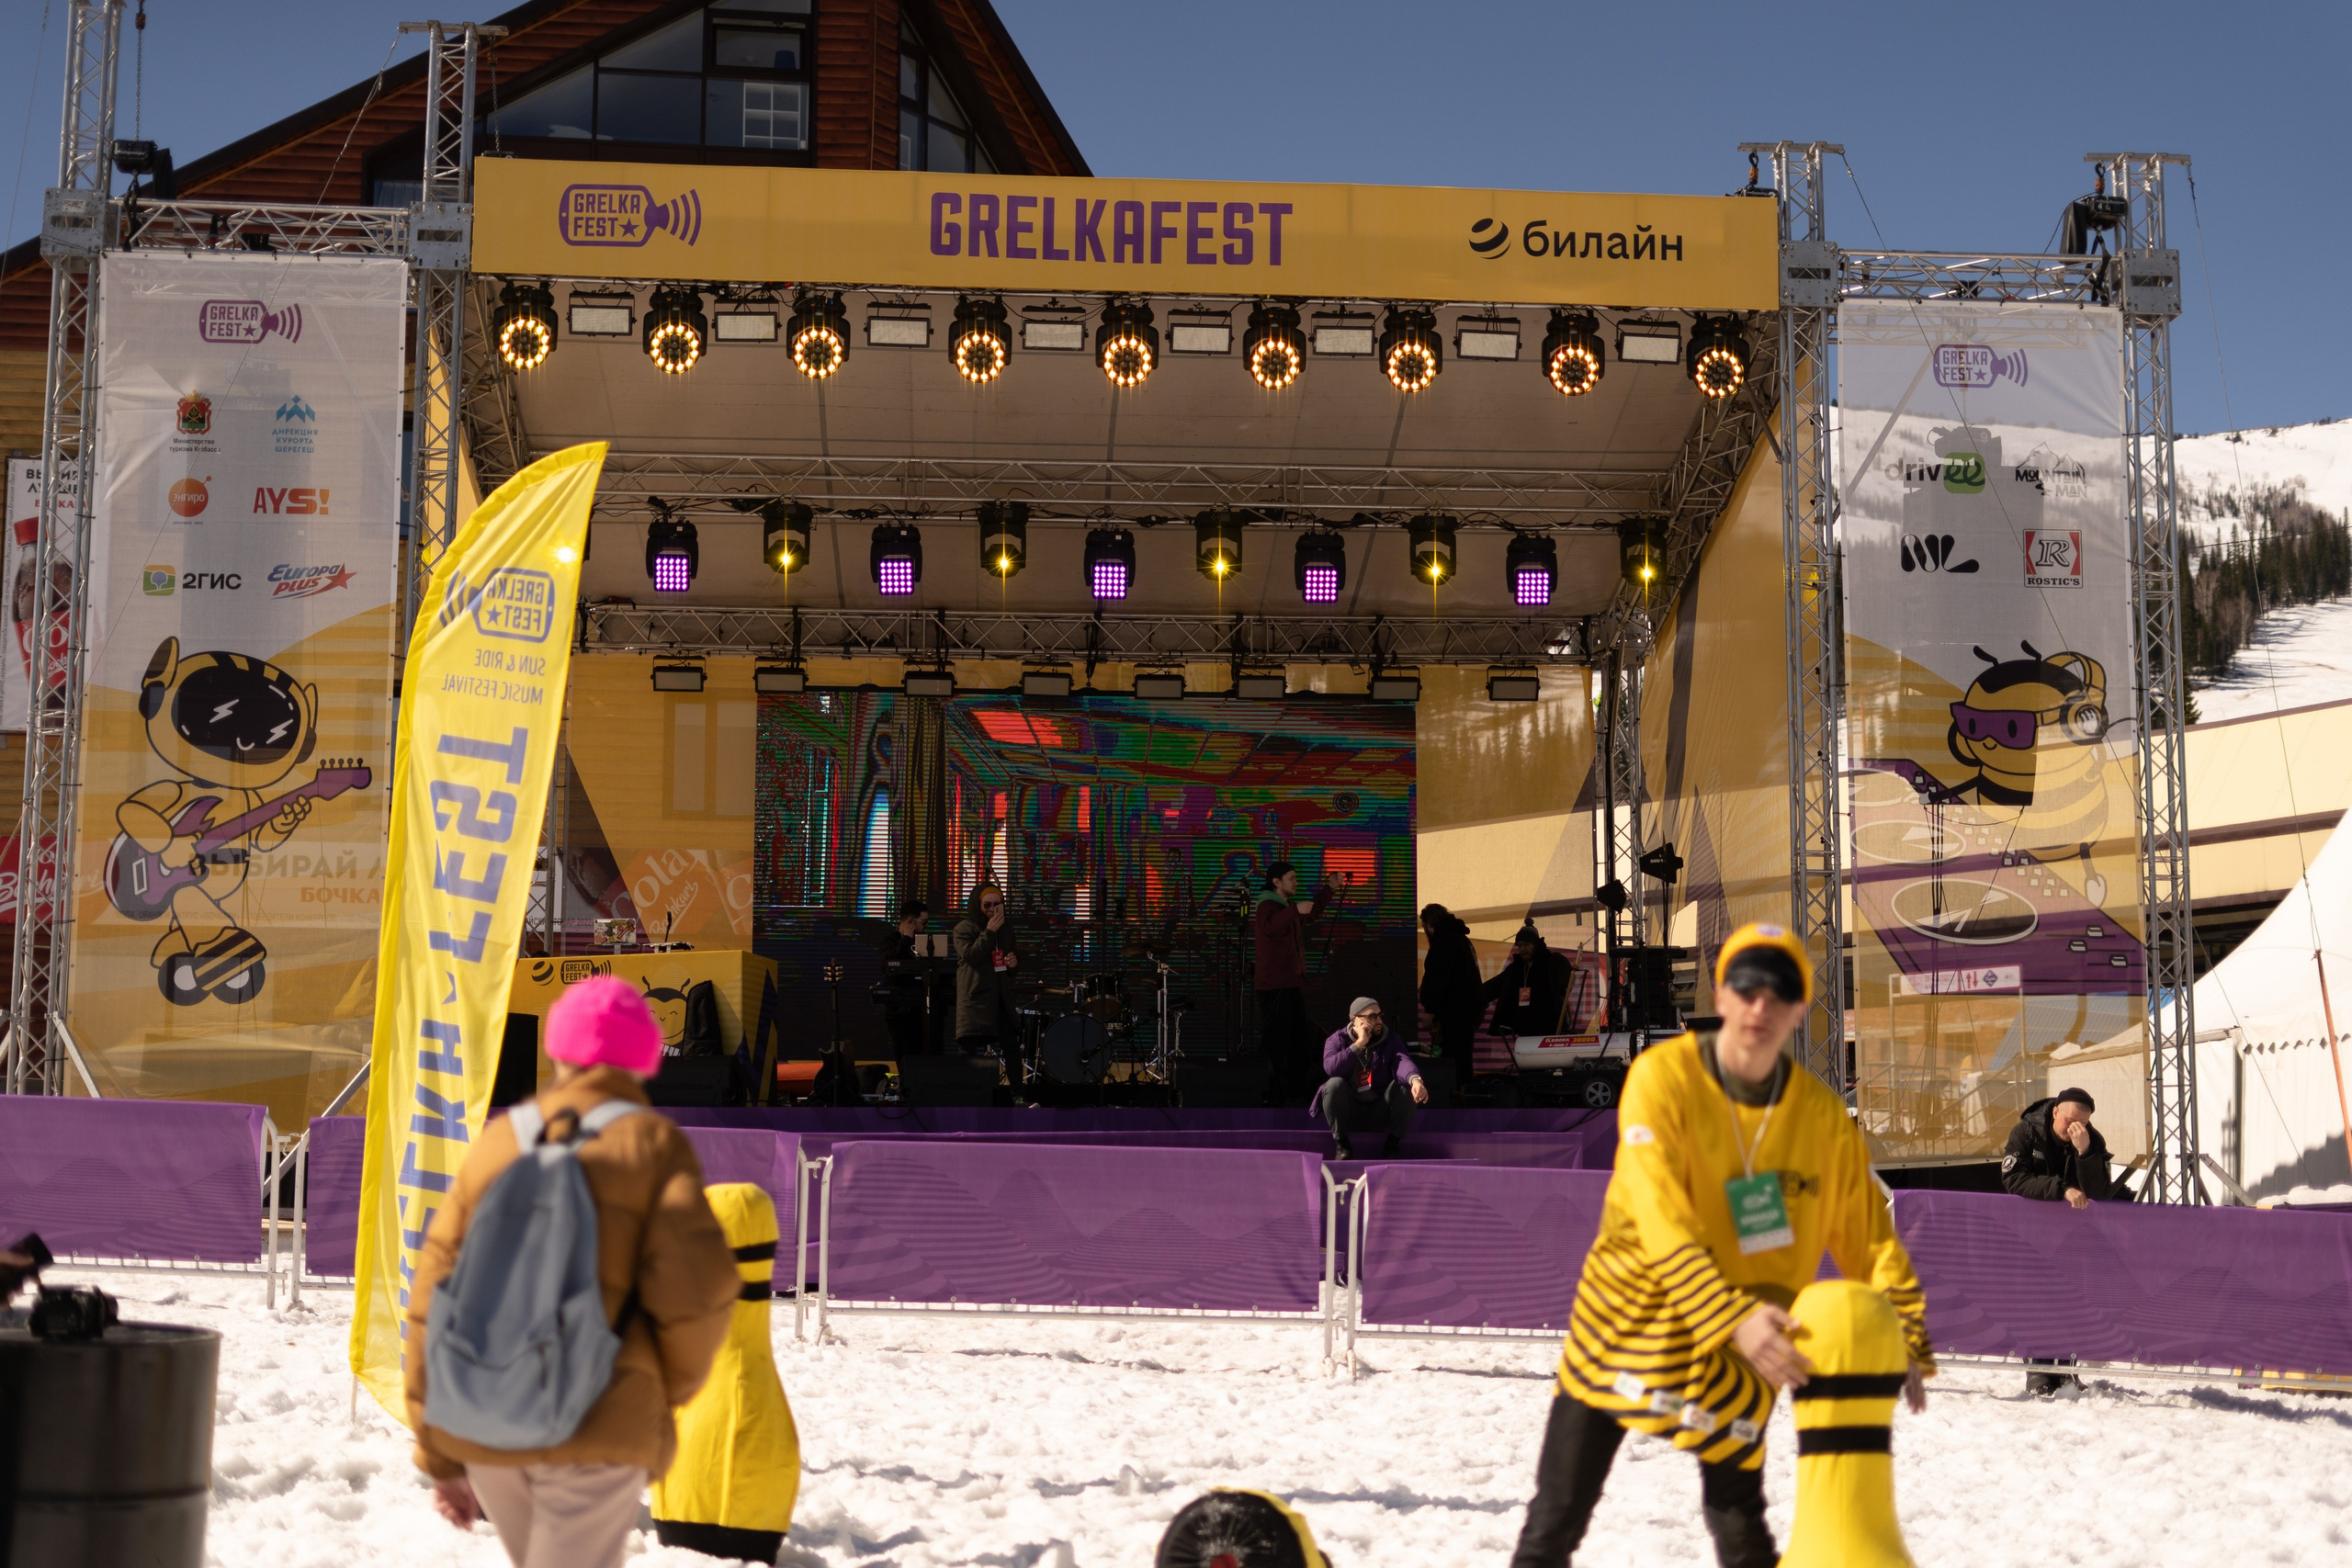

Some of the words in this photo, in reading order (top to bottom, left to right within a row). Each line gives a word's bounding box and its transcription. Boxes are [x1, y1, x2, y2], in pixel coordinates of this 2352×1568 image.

[573, 192, 641, 215] GRELKA
[572, 215, 619, 238] FEST
[930, 191, 1294, 266] GRELKAFEST
[1522, 220, 1684, 262] билайн
[209, 305, 258, 321] GRELKA
[209, 321, 243, 337] FEST
[1942, 350, 1988, 366] GRELKA
[1943, 367, 1973, 381] FEST
[271, 428, 318, 436] ДИРЕКЦИЯ
[169, 446, 194, 454] туризма
[194, 446, 221, 454] Кузбасса
[173, 438, 215, 446] Министерство
[275, 446, 314, 454] ШЕРЕГЕШ
[2015, 468, 2086, 485] MOUNTAIN
[172, 493, 205, 504] энгиро
[2055, 484, 2088, 498] MAN
[253, 487, 330, 515] AYS!
[182, 572, 242, 590] 2ГИС
[2026, 577, 2081, 586] ROSTIC'S
[188, 850, 357, 879] ВЫБИРАЙ
[300, 886, 380, 904] БОЧКА
[565, 963, 590, 972] GRELKA
[565, 972, 582, 981] FEST
